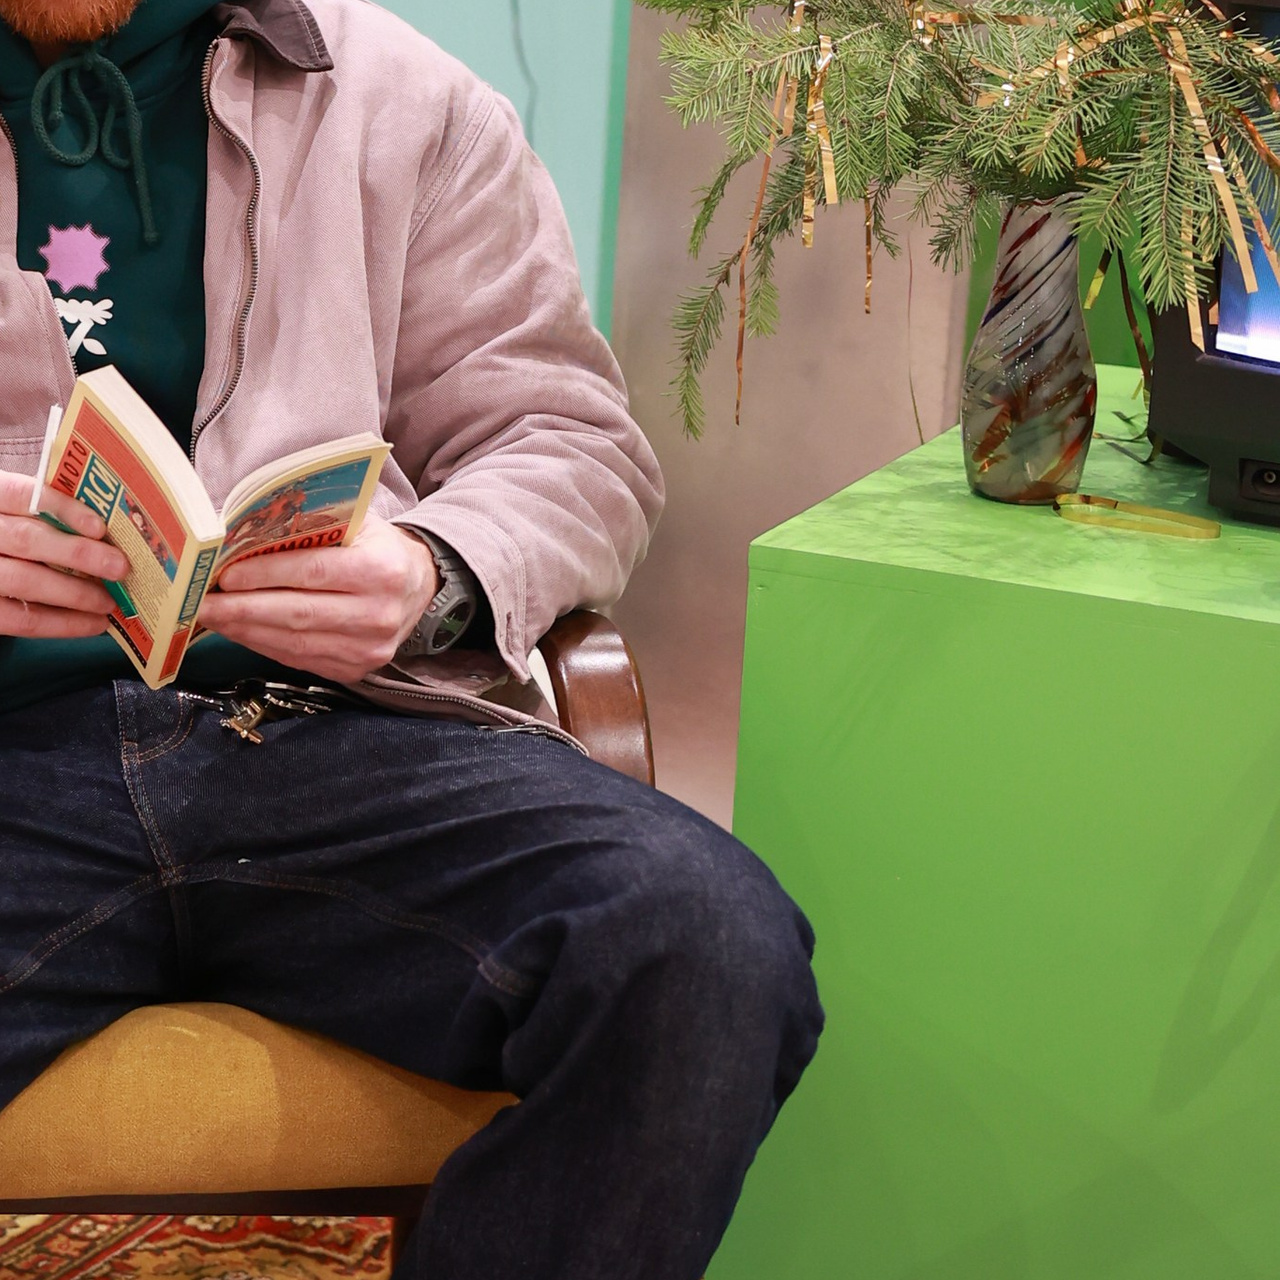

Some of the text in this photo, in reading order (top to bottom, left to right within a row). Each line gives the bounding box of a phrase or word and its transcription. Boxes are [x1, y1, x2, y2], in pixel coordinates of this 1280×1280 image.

[57, 440, 87, 493] МОТО
[80, 458, 119, 519] АСИ
[244, 528, 343, 559] ЯМОТО
